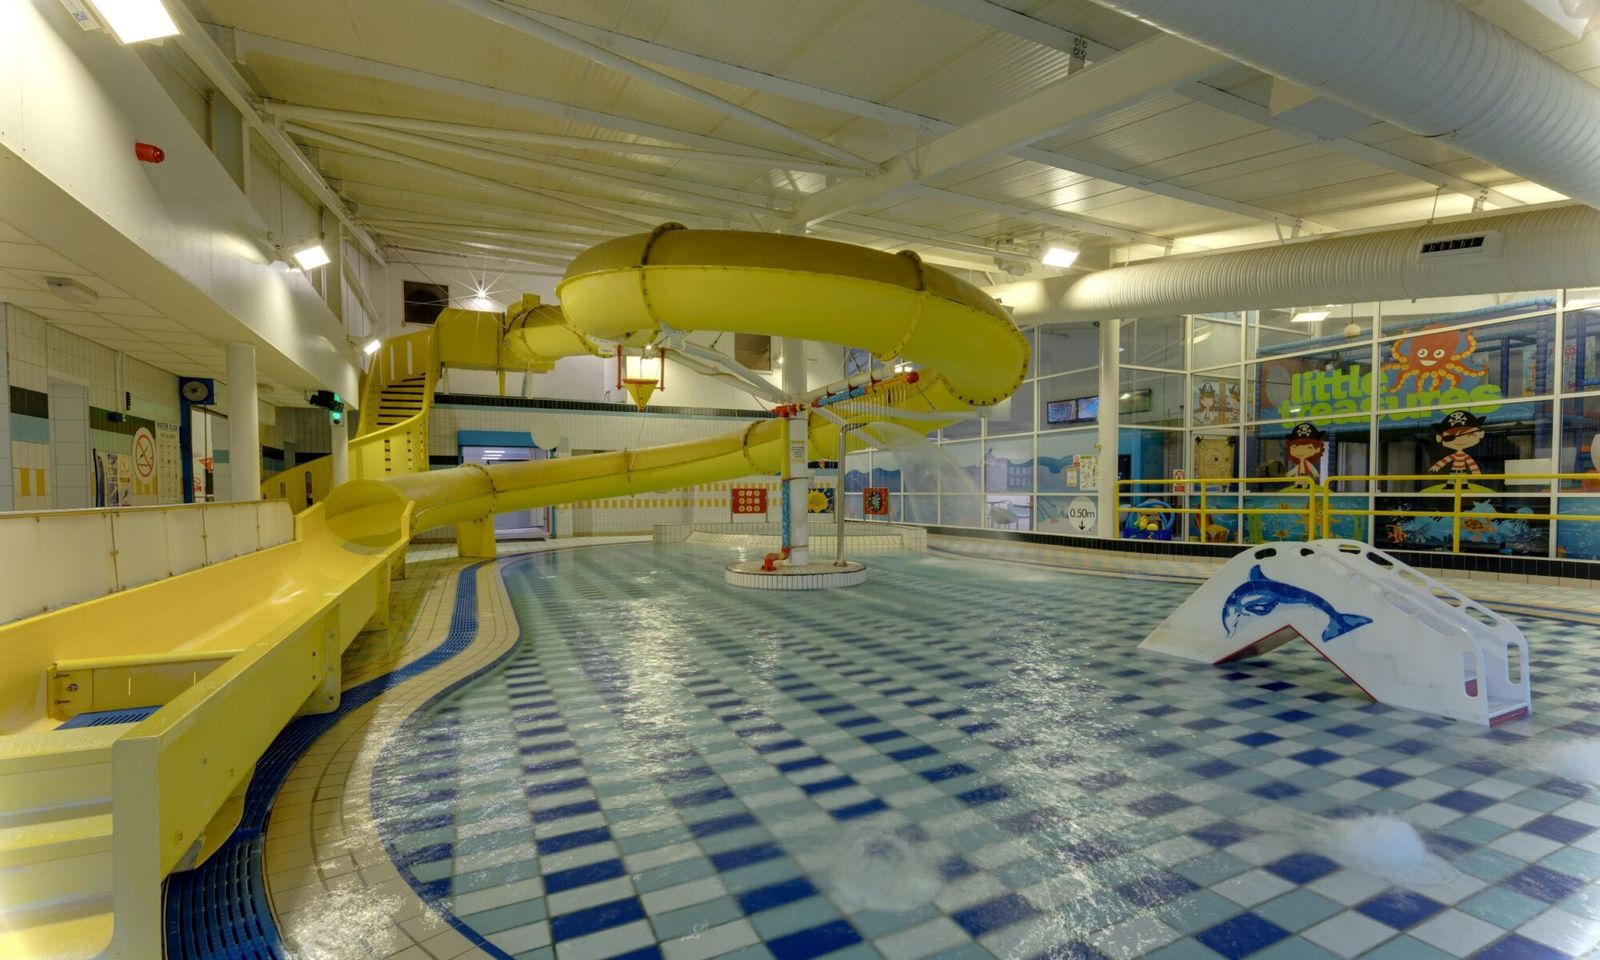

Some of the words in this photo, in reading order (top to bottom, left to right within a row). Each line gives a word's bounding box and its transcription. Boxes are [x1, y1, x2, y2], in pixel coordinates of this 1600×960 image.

[1291, 364, 1388, 403] little
[1278, 384, 1501, 428] treasures
[1070, 508, 1095, 518] 0.50m
